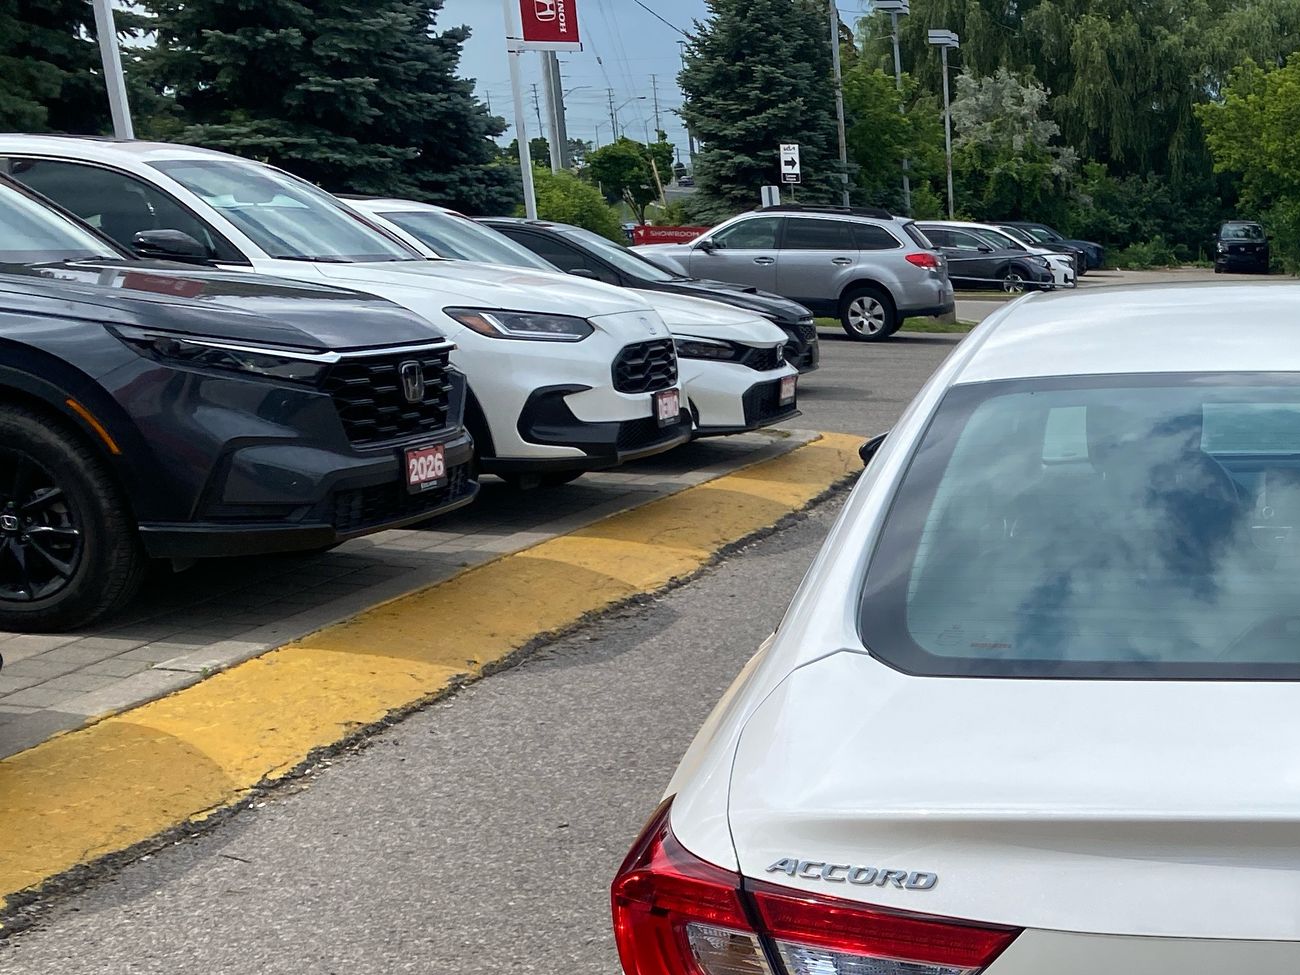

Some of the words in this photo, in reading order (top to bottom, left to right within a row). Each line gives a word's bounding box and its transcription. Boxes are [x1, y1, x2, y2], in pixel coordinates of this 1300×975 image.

[558, 0, 567, 33] HON
[410, 453, 444, 484] 2026
[765, 857, 938, 890] ACCORD
